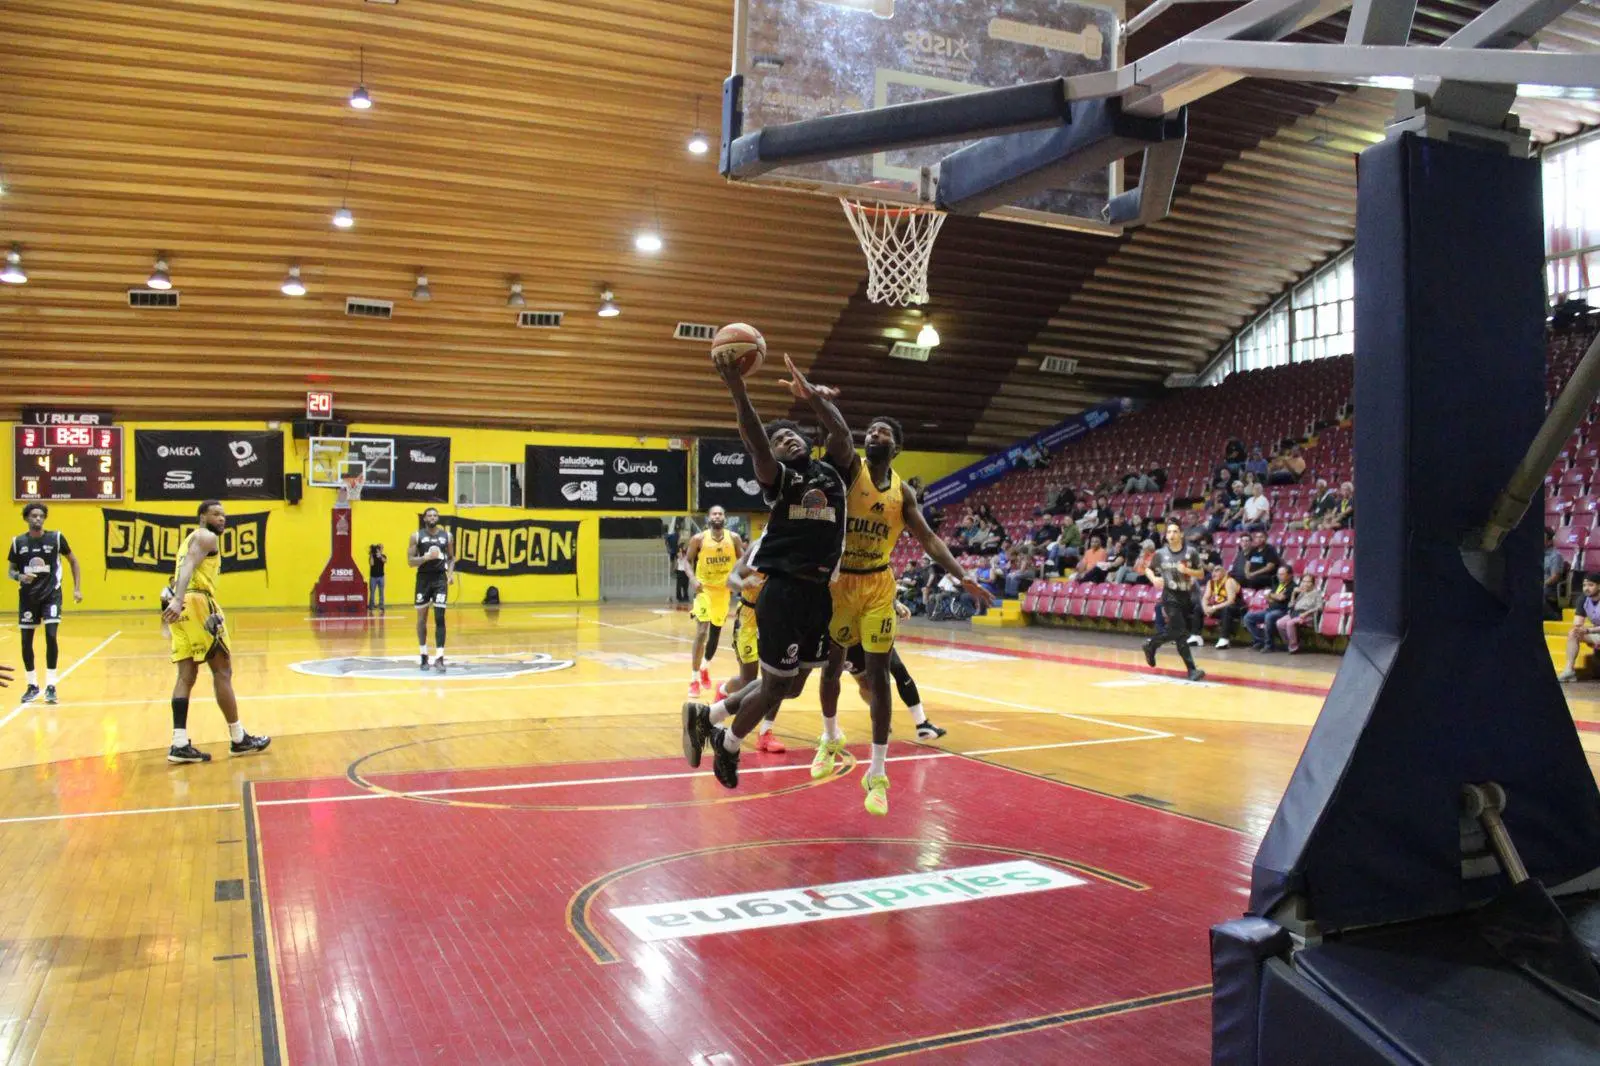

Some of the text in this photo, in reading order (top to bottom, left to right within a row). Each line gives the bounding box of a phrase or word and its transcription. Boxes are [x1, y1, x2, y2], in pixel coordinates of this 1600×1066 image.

[309, 394, 330, 411] 20
[51, 413, 100, 425] RULER
[25, 433, 36, 447] 2
[56, 427, 90, 445] 8:26
[101, 434, 112, 448] 2
[22, 448, 52, 456] GUEST
[87, 448, 112, 456] HOME
[168, 446, 201, 457] MEGA
[38, 455, 50, 473] 4
[99, 456, 112, 473] 2
[559, 456, 604, 468] SaludDigna
[616, 457, 658, 474] Kuroda
[27, 480, 38, 495] 0
[103, 480, 113, 495] 0
[163, 481, 195, 490] SoniGas
[226, 478, 263, 486] VENTO
[880, 617, 892, 634] 15
[645, 869, 1052, 929] SaludDigna
